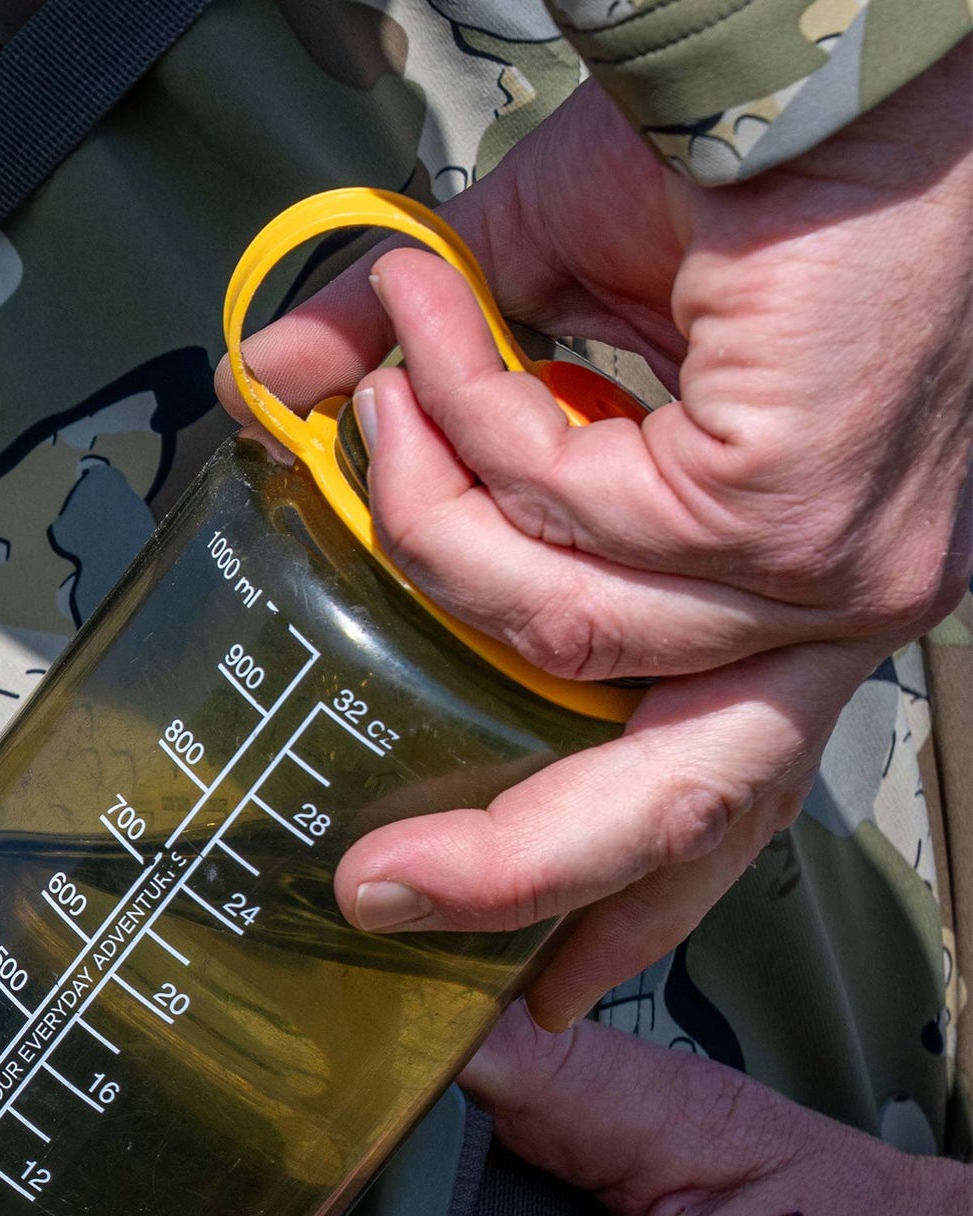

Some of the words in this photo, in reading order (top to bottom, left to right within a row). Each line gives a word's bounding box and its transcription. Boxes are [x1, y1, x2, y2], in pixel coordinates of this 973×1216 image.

[207, 531, 240, 579] 1000
[234, 576, 263, 608] ml
[225, 644, 265, 689] 900
[333, 689, 368, 724] 32
[164, 719, 204, 765] 800
[107, 793, 146, 840] 700
[293, 803, 331, 836] 28
[48, 872, 87, 916] 600
[222, 893, 261, 926] 24
[17, 966, 93, 1063] EVERYDAY
[93, 851, 187, 971] ADVENTURS
[152, 982, 190, 1015] 20
[89, 1073, 120, 1103] 16
[21, 1161, 51, 1192] 12
